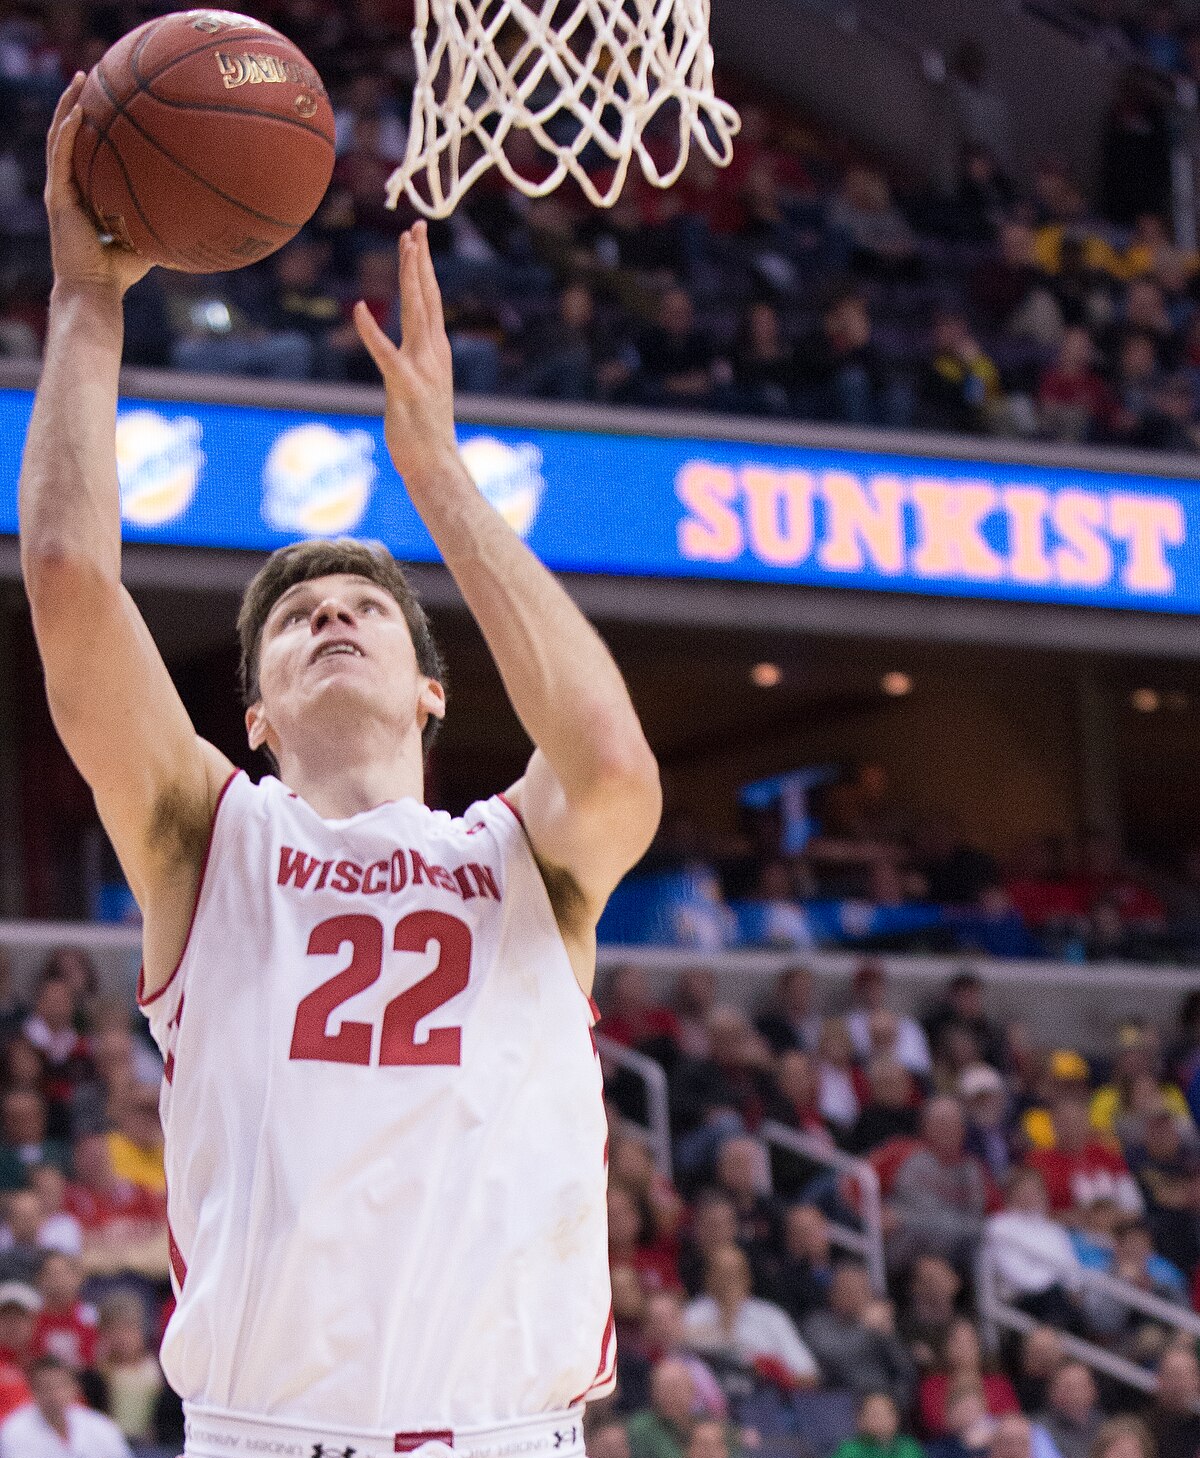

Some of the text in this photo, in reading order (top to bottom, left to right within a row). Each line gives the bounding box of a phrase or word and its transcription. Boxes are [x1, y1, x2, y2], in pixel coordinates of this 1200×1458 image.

[677, 462, 1185, 595] SUNKIST
[277, 846, 501, 902] WISCONSIN
[289, 909, 472, 1067] 22
